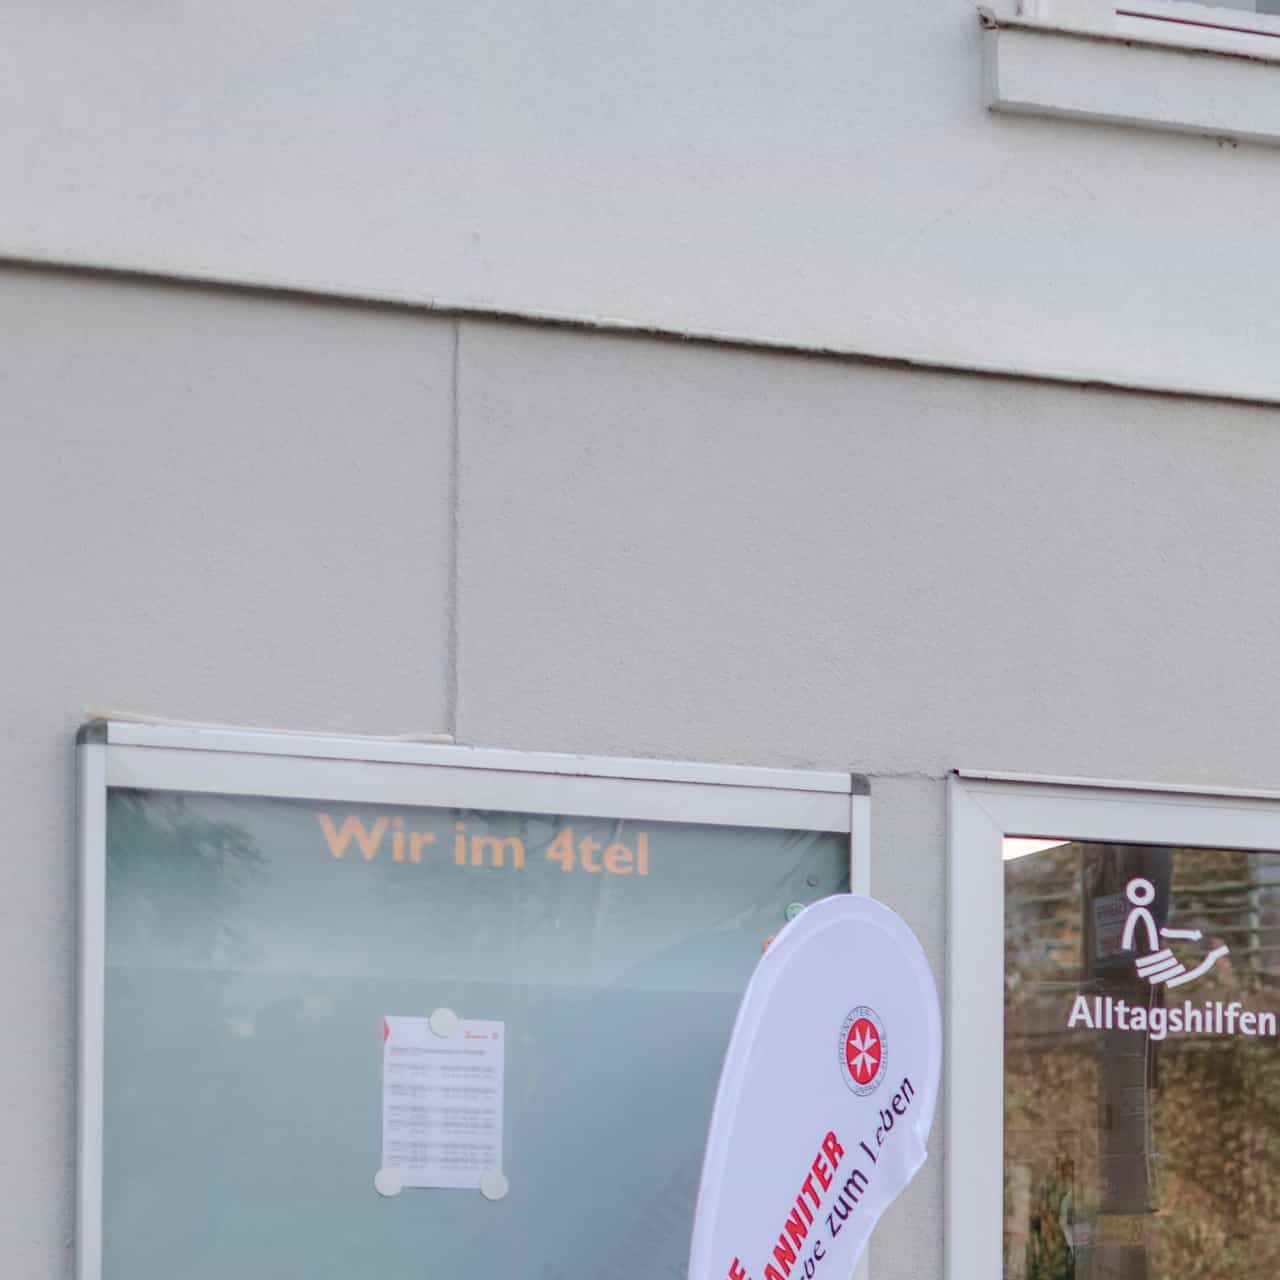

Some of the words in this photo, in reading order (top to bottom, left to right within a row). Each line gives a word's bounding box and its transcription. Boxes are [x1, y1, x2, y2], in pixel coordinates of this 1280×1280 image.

[317, 812, 436, 863] Wir
[455, 820, 527, 869] im
[546, 826, 650, 876] 4tel
[1067, 994, 1277, 1041] Alltagshilfen
[825, 1167, 870, 1238] zum
